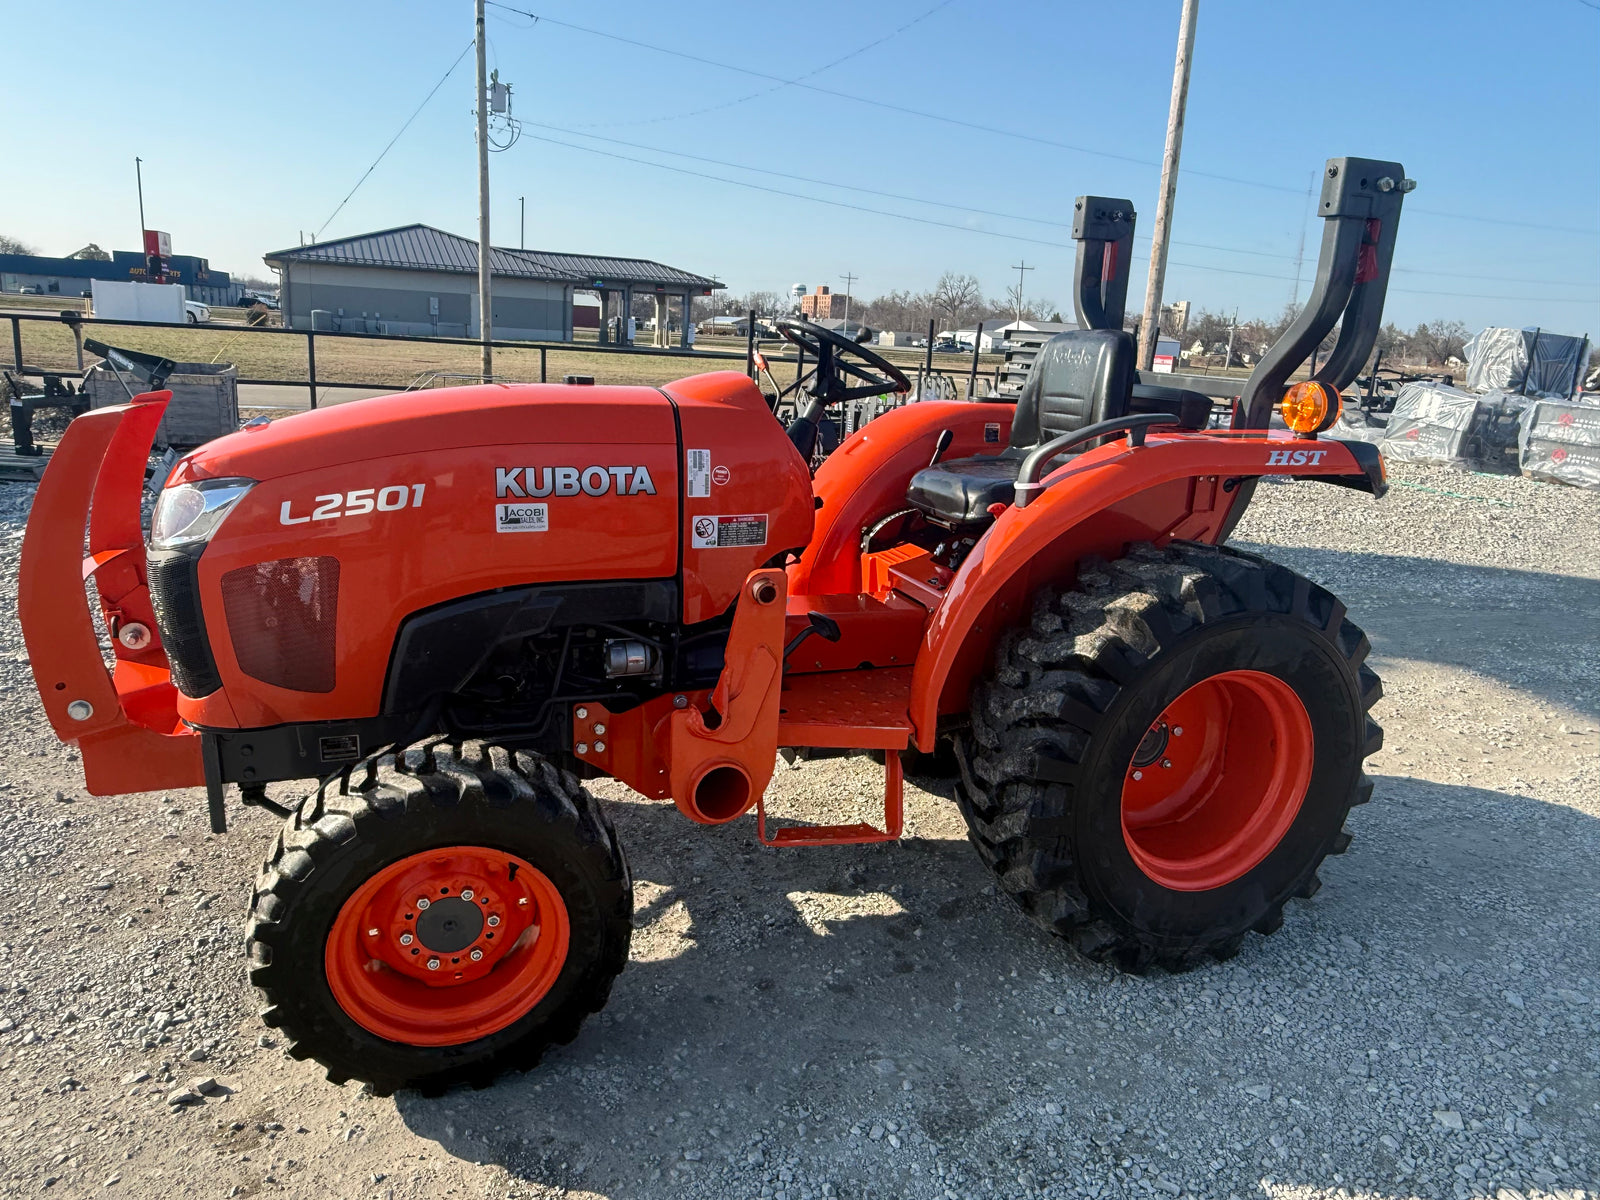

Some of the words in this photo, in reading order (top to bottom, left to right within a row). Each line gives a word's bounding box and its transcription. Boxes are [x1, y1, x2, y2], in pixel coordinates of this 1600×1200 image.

[1265, 450, 1327, 466] HST
[495, 465, 657, 498] KUBOTA
[279, 483, 426, 526] L2501
[500, 505, 544, 521] JACOBI
